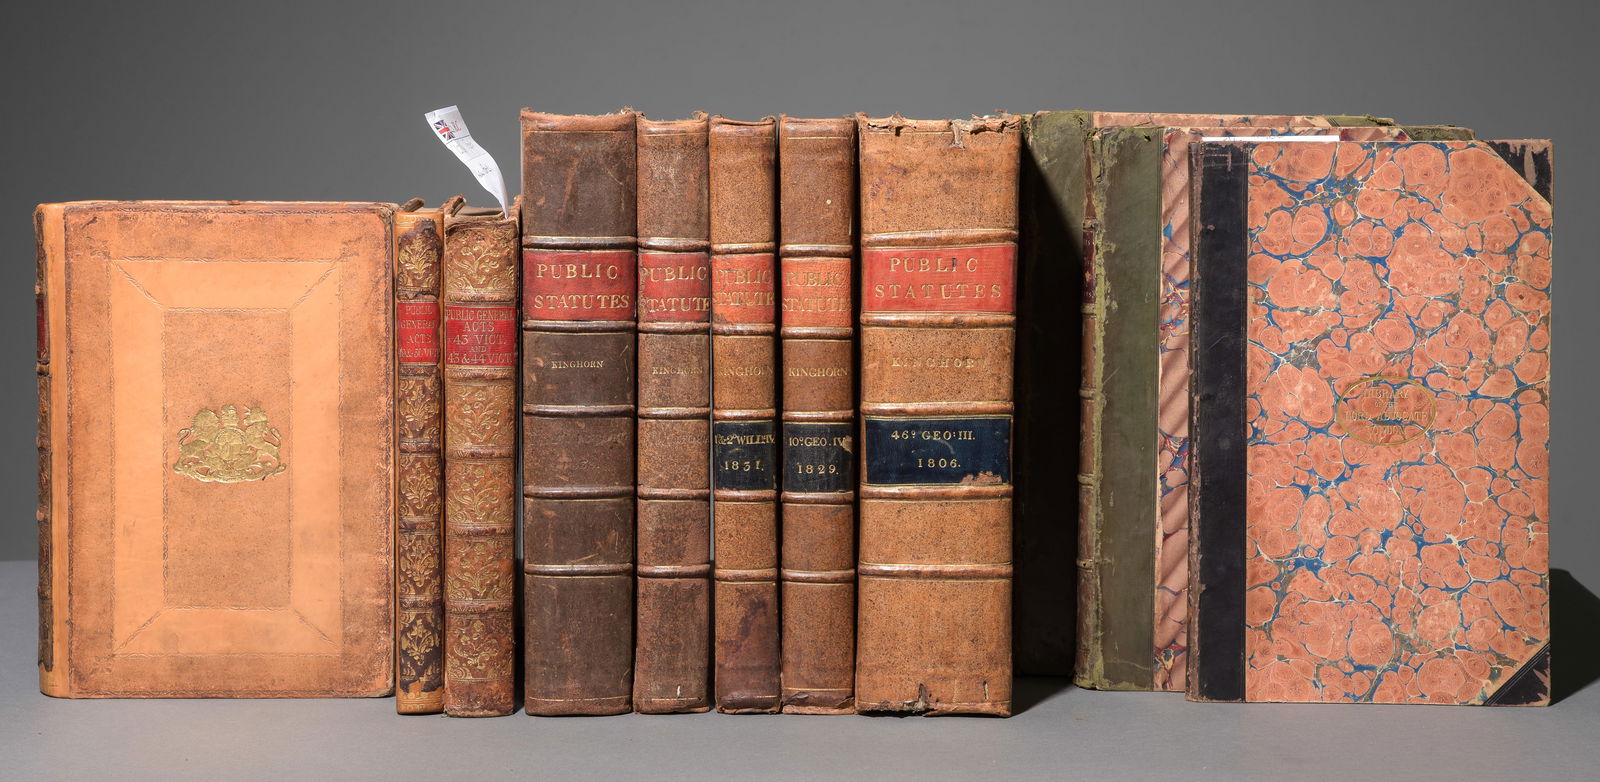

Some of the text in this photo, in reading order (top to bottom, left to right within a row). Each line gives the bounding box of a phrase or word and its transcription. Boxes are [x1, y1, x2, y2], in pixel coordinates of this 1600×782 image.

[889, 257, 978, 272] PUBLIC
[536, 263, 618, 279] PUBLIC
[640, 265, 707, 282] PUBLIC
[715, 269, 772, 284] PUBLIC
[786, 272, 845, 287] PUBLIC
[875, 283, 1003, 299] STATUTES
[534, 294, 629, 309] STATUTES
[446, 309, 515, 321] PUBLIC GENERAL
[462, 321, 495, 332] ACTS
[453, 334, 507, 345] 43 VICT.
[469, 345, 487, 353] AND
[551, 360, 604, 369] KINGHORN
[788, 367, 848, 377] KINGHORN
[918, 458, 961, 468] 1806.
[797, 464, 839, 475] 1829.
